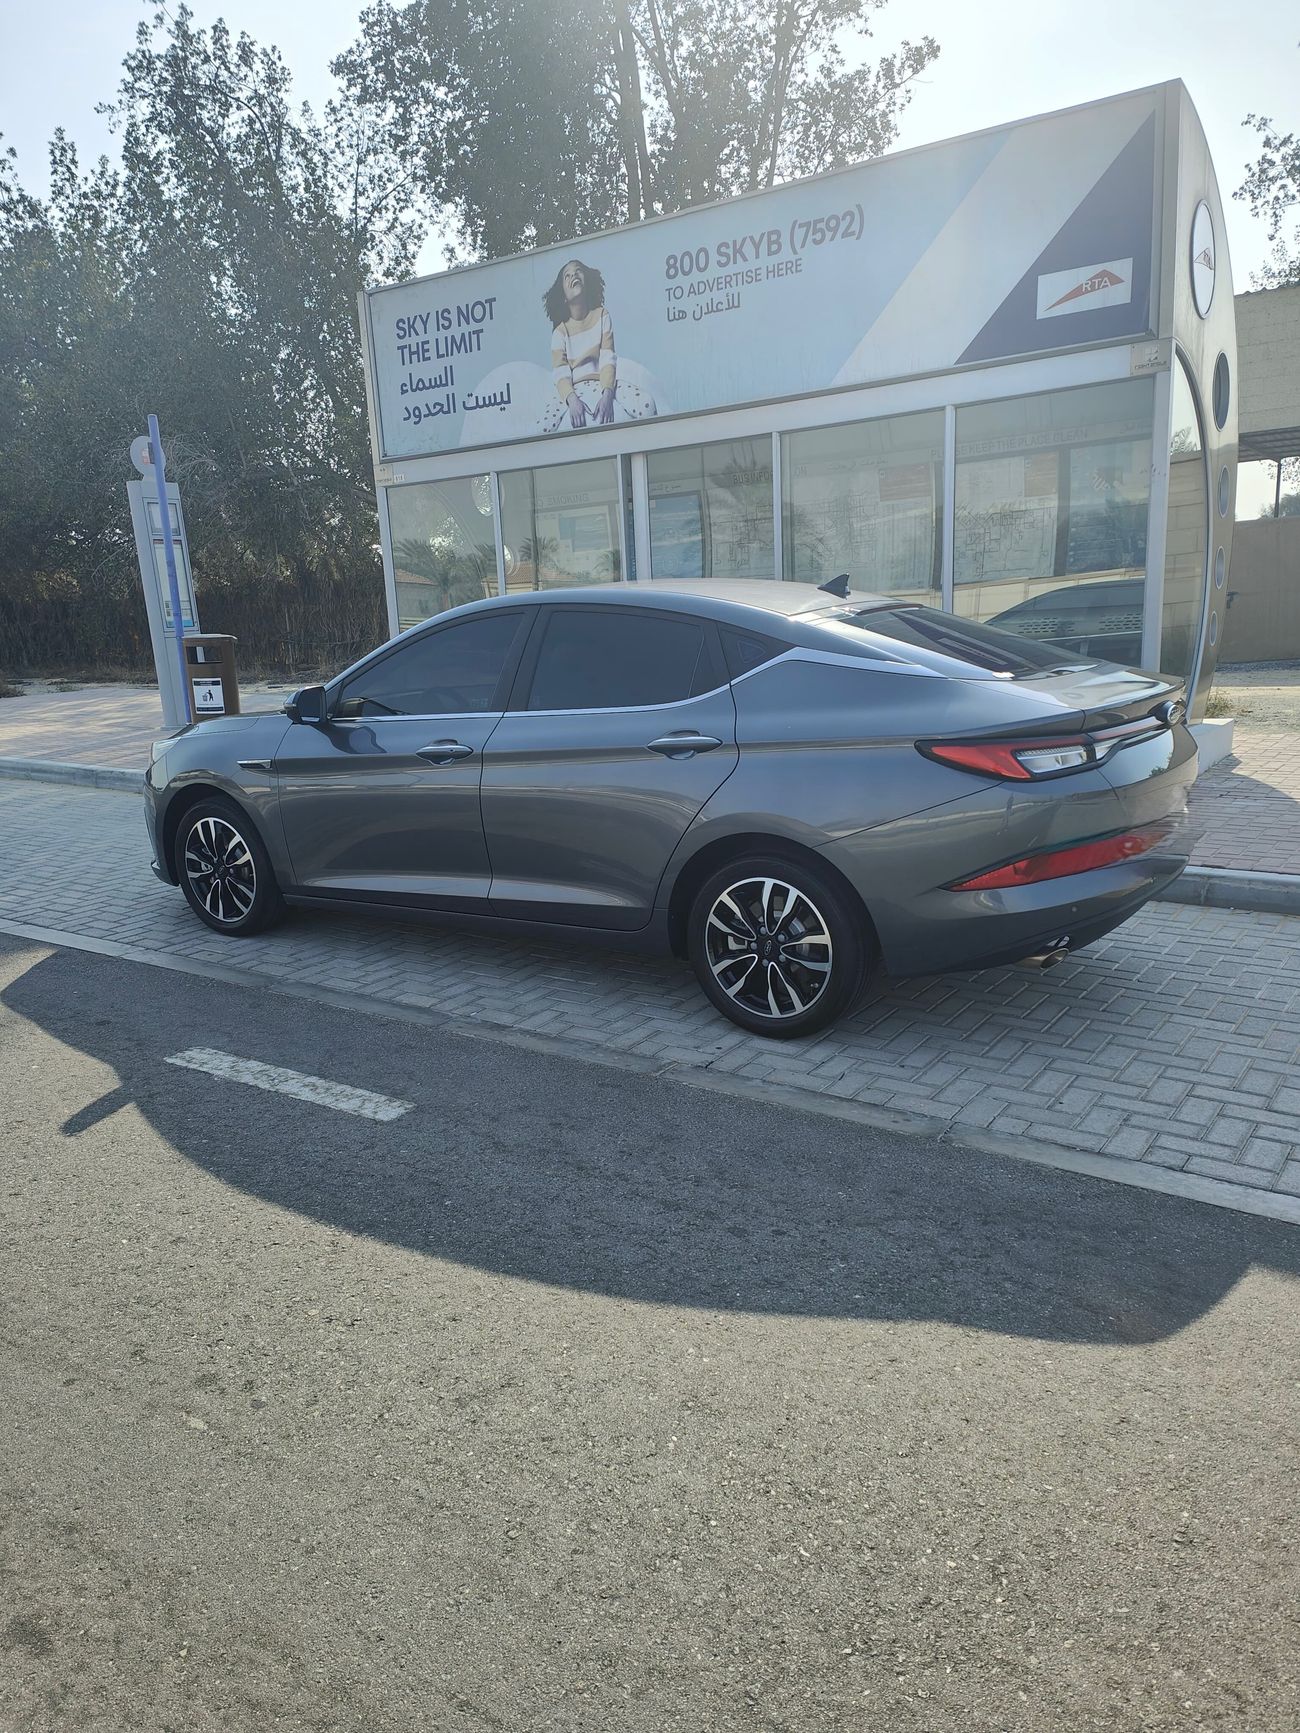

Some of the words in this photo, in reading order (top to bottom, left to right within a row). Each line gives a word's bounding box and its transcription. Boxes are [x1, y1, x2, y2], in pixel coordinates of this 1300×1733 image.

[665, 246, 710, 280] 800
[716, 229, 783, 269] SKYB
[789, 203, 865, 256] (7592)
[665, 285, 684, 302] TO
[687, 266, 762, 298] ADVERTISE
[766, 257, 803, 281] HERE
[1082, 276, 1111, 292] RTA
[395, 312, 431, 340] SKY
[435, 308, 453, 332] IS
[456, 296, 497, 328] NOT
[666, 306, 687, 323] هنا
[396, 339, 431, 366] THE
[435, 328, 484, 360] LIMIT
[400, 365, 455, 396] السماء
[462, 382, 512, 412] ليست
[402, 392, 457, 426] الحدود
